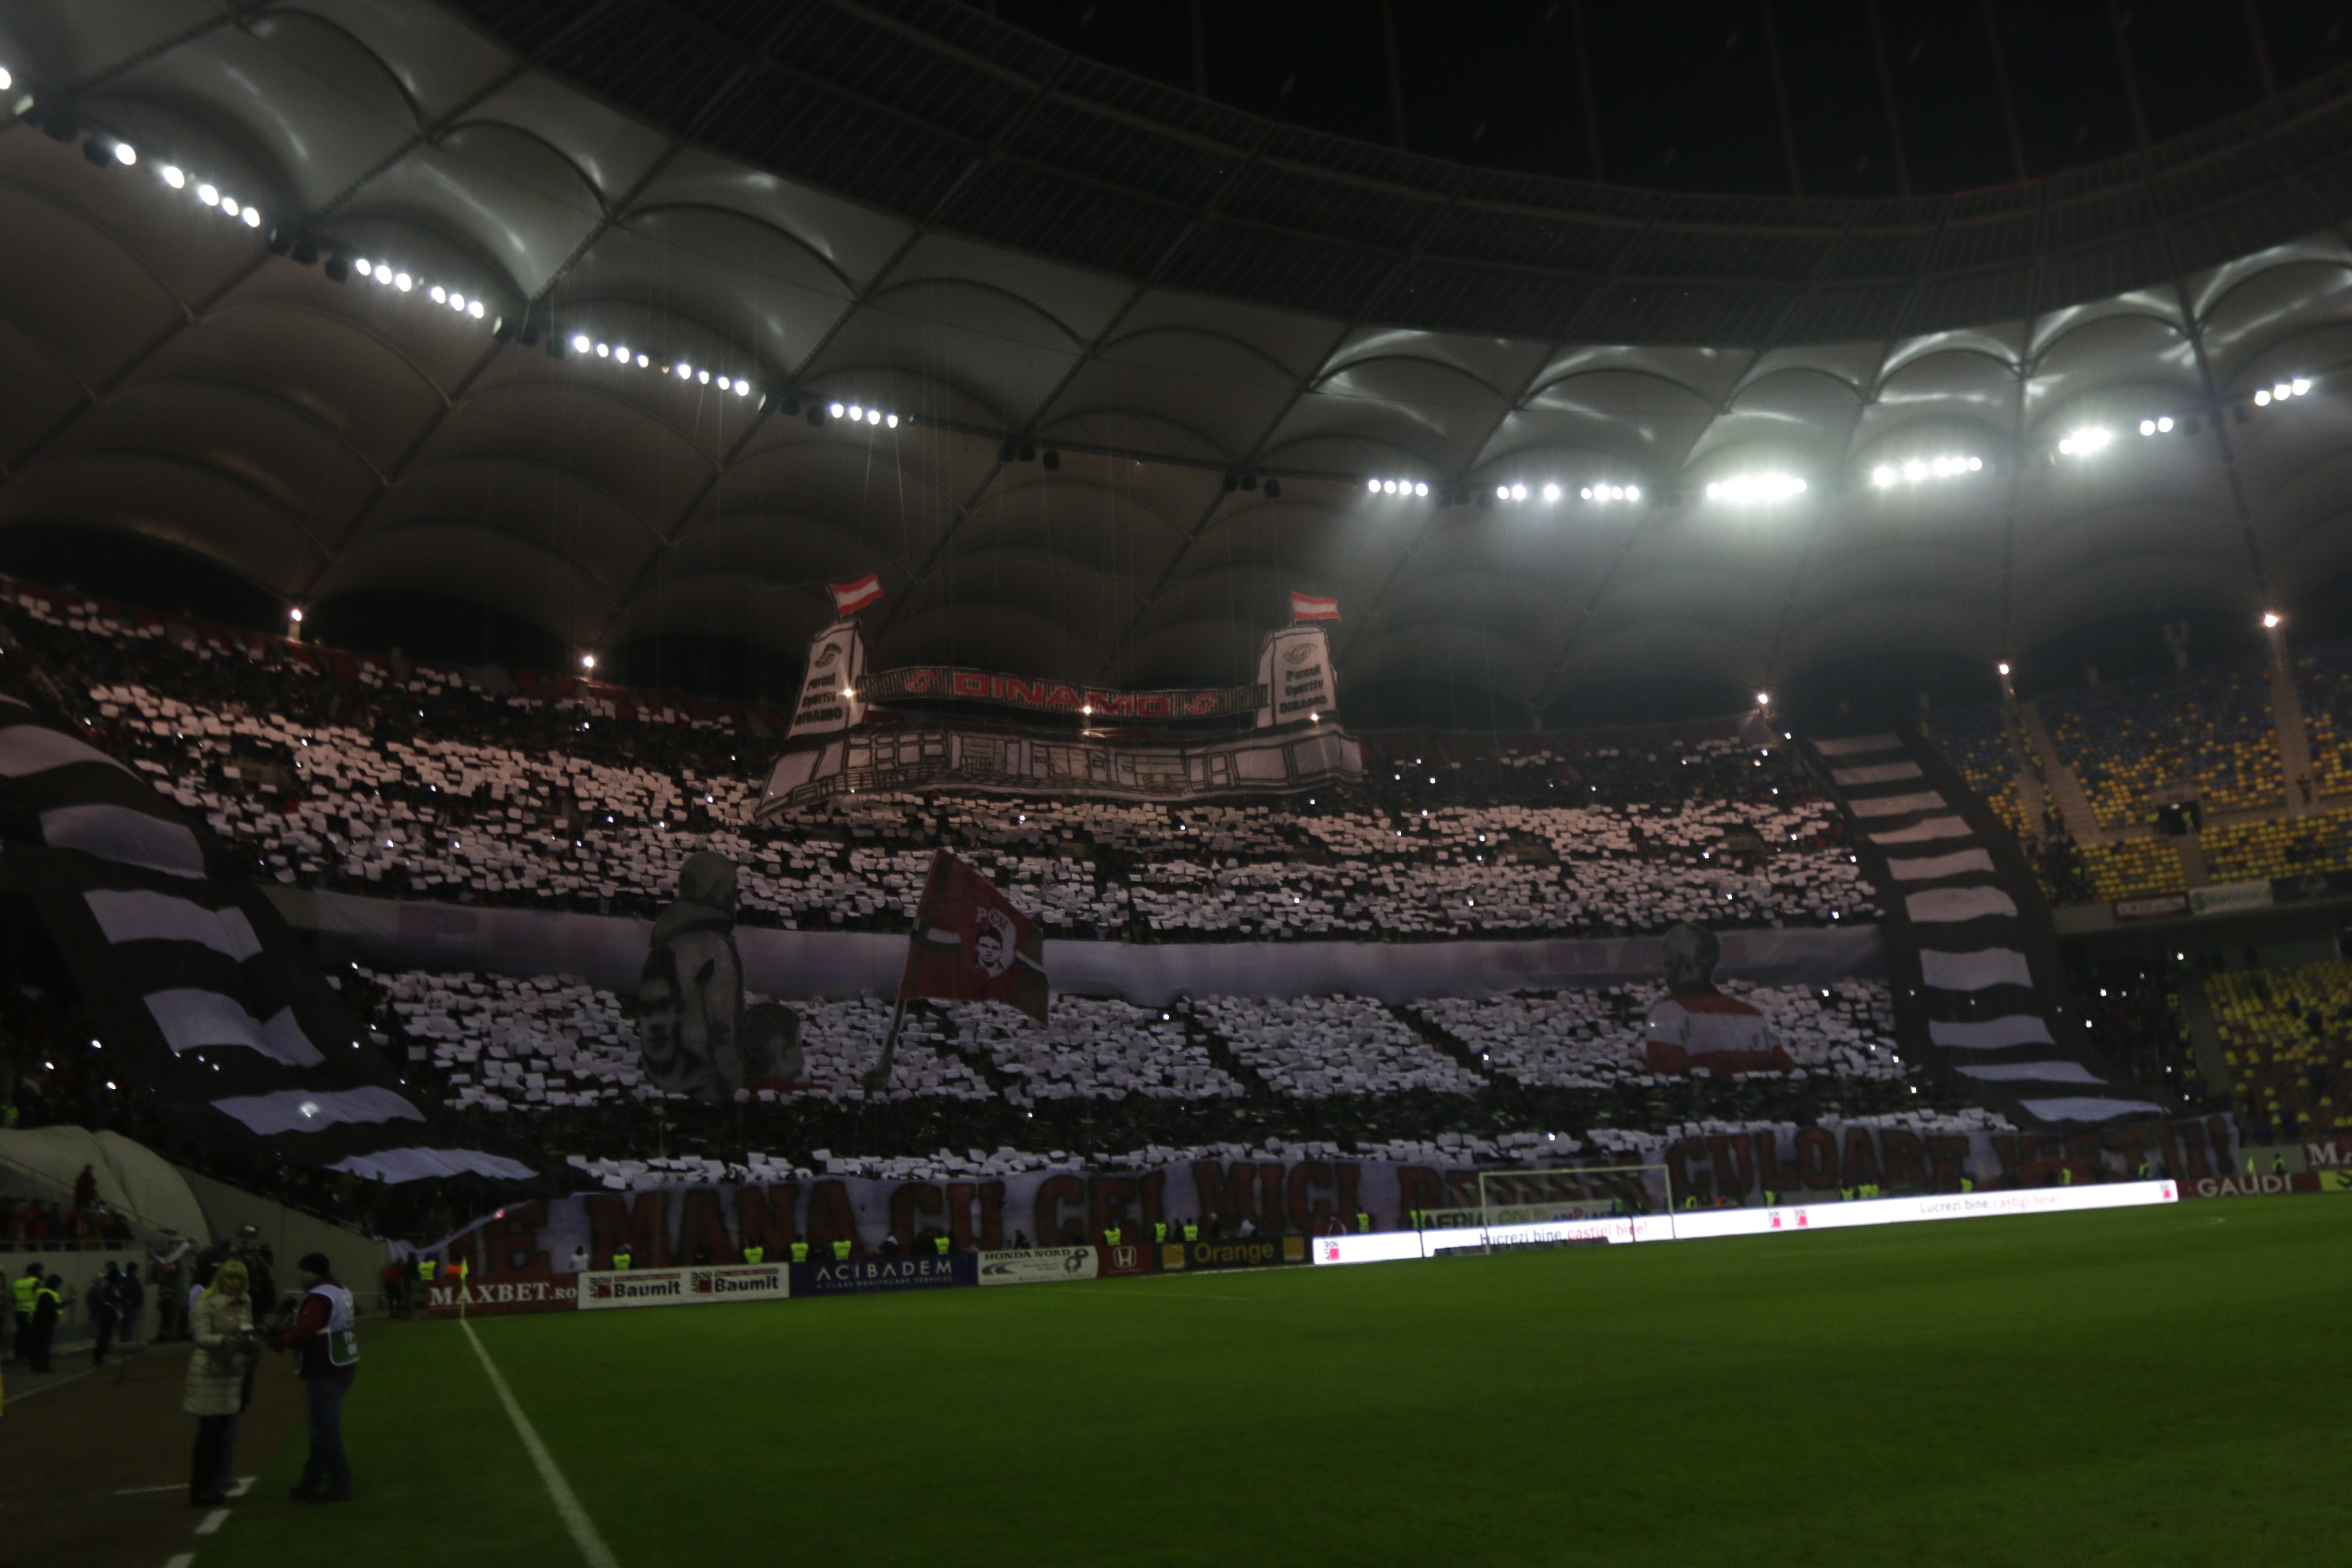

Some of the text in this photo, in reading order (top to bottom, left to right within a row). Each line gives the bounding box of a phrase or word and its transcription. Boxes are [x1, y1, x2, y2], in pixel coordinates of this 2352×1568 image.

[954, 673, 1169, 717] DINAMO
[2197, 1174, 2293, 1197] GAUDI
[985, 1249, 1070, 1260] HONDA NORD
[1194, 1243, 1274, 1264] Orange
[817, 1259, 953, 1281] ACIBADEM
[429, 1282, 578, 1306] MAXBET.RO
[615, 1280, 681, 1297] Baumit
[715, 1275, 778, 1292] Baumit
